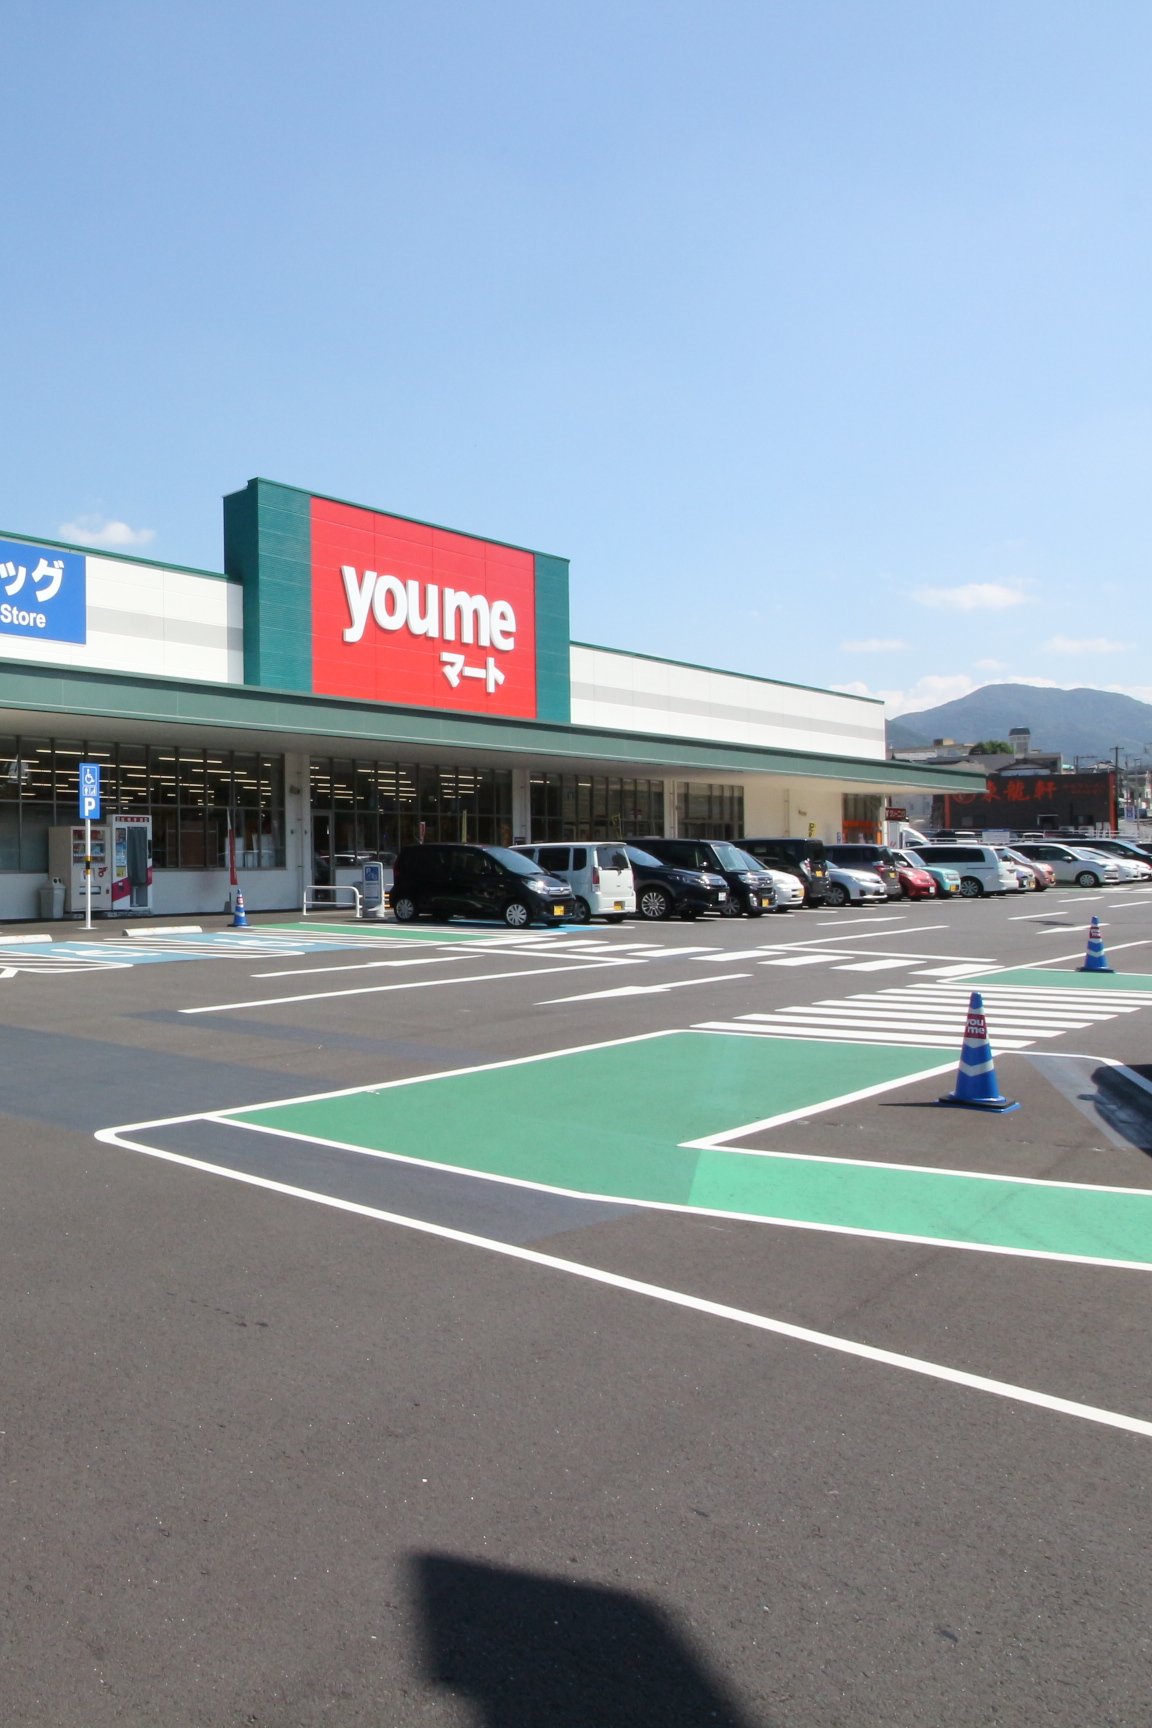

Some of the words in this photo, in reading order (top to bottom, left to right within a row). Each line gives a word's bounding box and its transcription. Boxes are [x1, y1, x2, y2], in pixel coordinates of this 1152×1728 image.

[0, 603, 47, 629] Store
[340, 564, 517, 651] youme
[439, 651, 506, 694] マート
[84, 797, 96, 817] P
[967, 1026, 984, 1034] me
